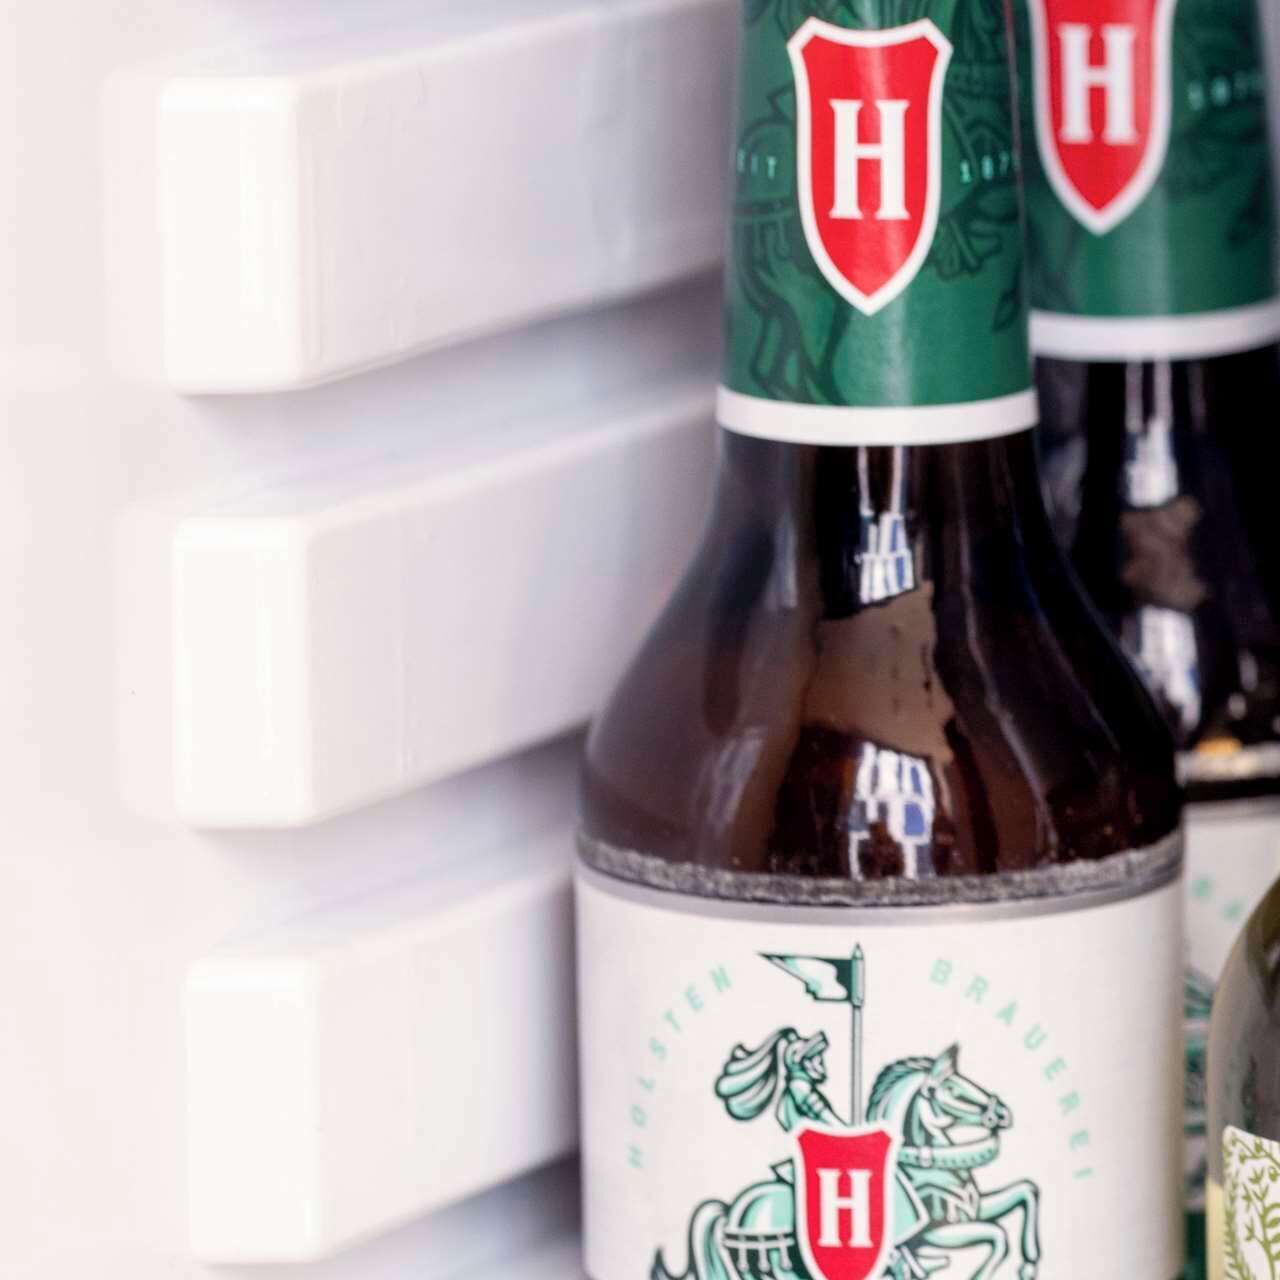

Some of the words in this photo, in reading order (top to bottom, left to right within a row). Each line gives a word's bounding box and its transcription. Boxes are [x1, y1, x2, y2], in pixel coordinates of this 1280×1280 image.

[1059, 22, 1137, 144] H
[829, 99, 910, 219] H
[816, 1168, 874, 1248] H
